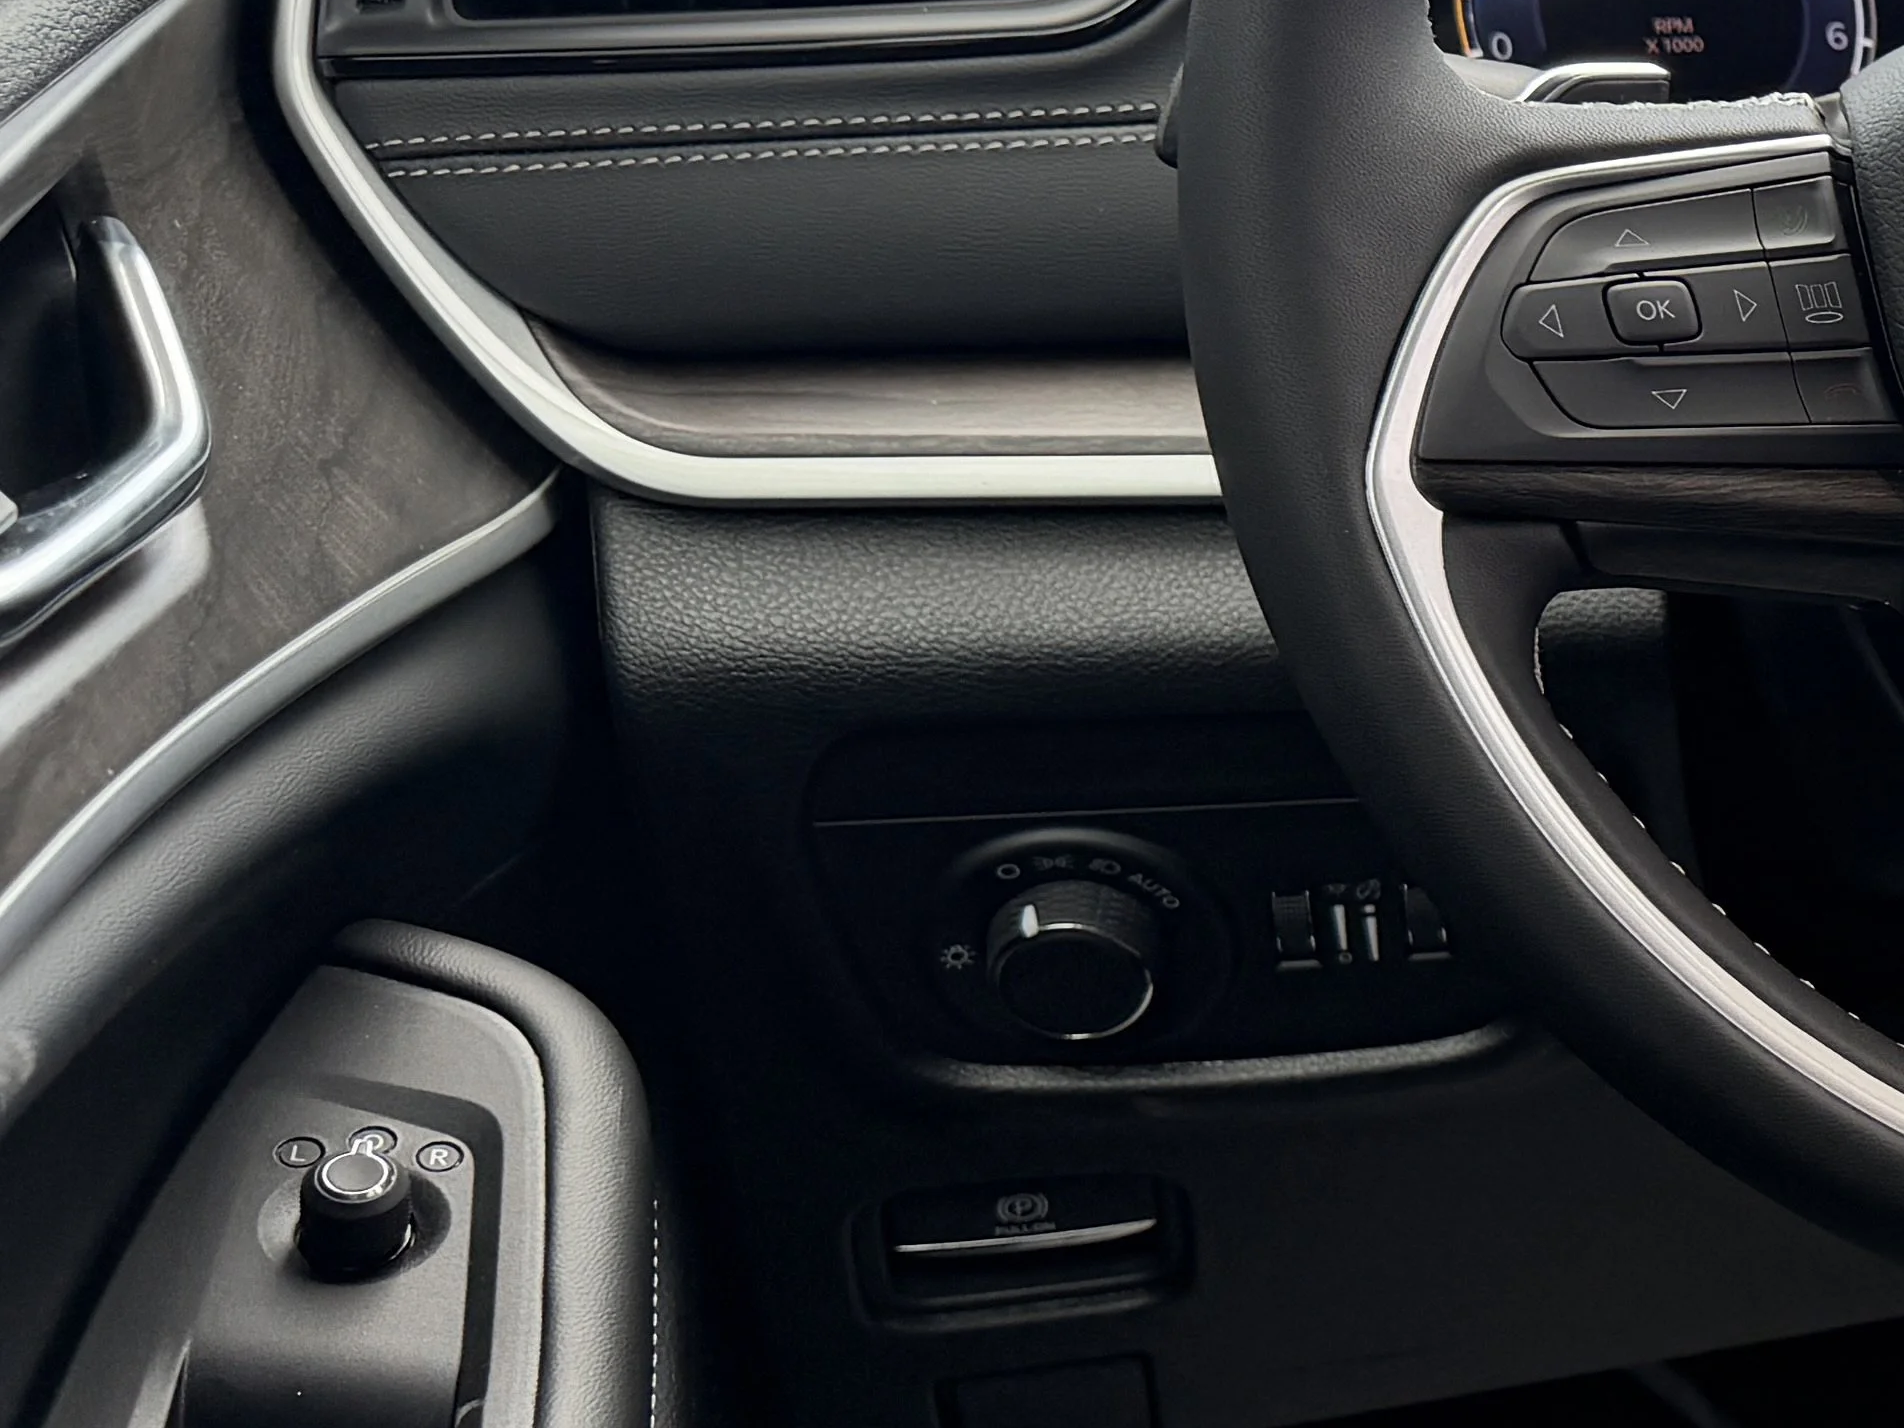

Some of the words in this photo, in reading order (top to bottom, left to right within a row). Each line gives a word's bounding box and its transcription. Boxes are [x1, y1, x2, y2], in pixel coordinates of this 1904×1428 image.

[1651, 16, 1695, 35] RPM
[1825, 21, 1849, 51] 6
[1490, 31, 1514, 62] 0
[1643, 37, 1659, 55] X
[1664, 34, 1704, 55] 1000
[1635, 299, 1676, 322] OK
[1126, 871, 1181, 911] AUTO
[289, 1144, 306, 1163] L
[428, 1148, 449, 1167] R
